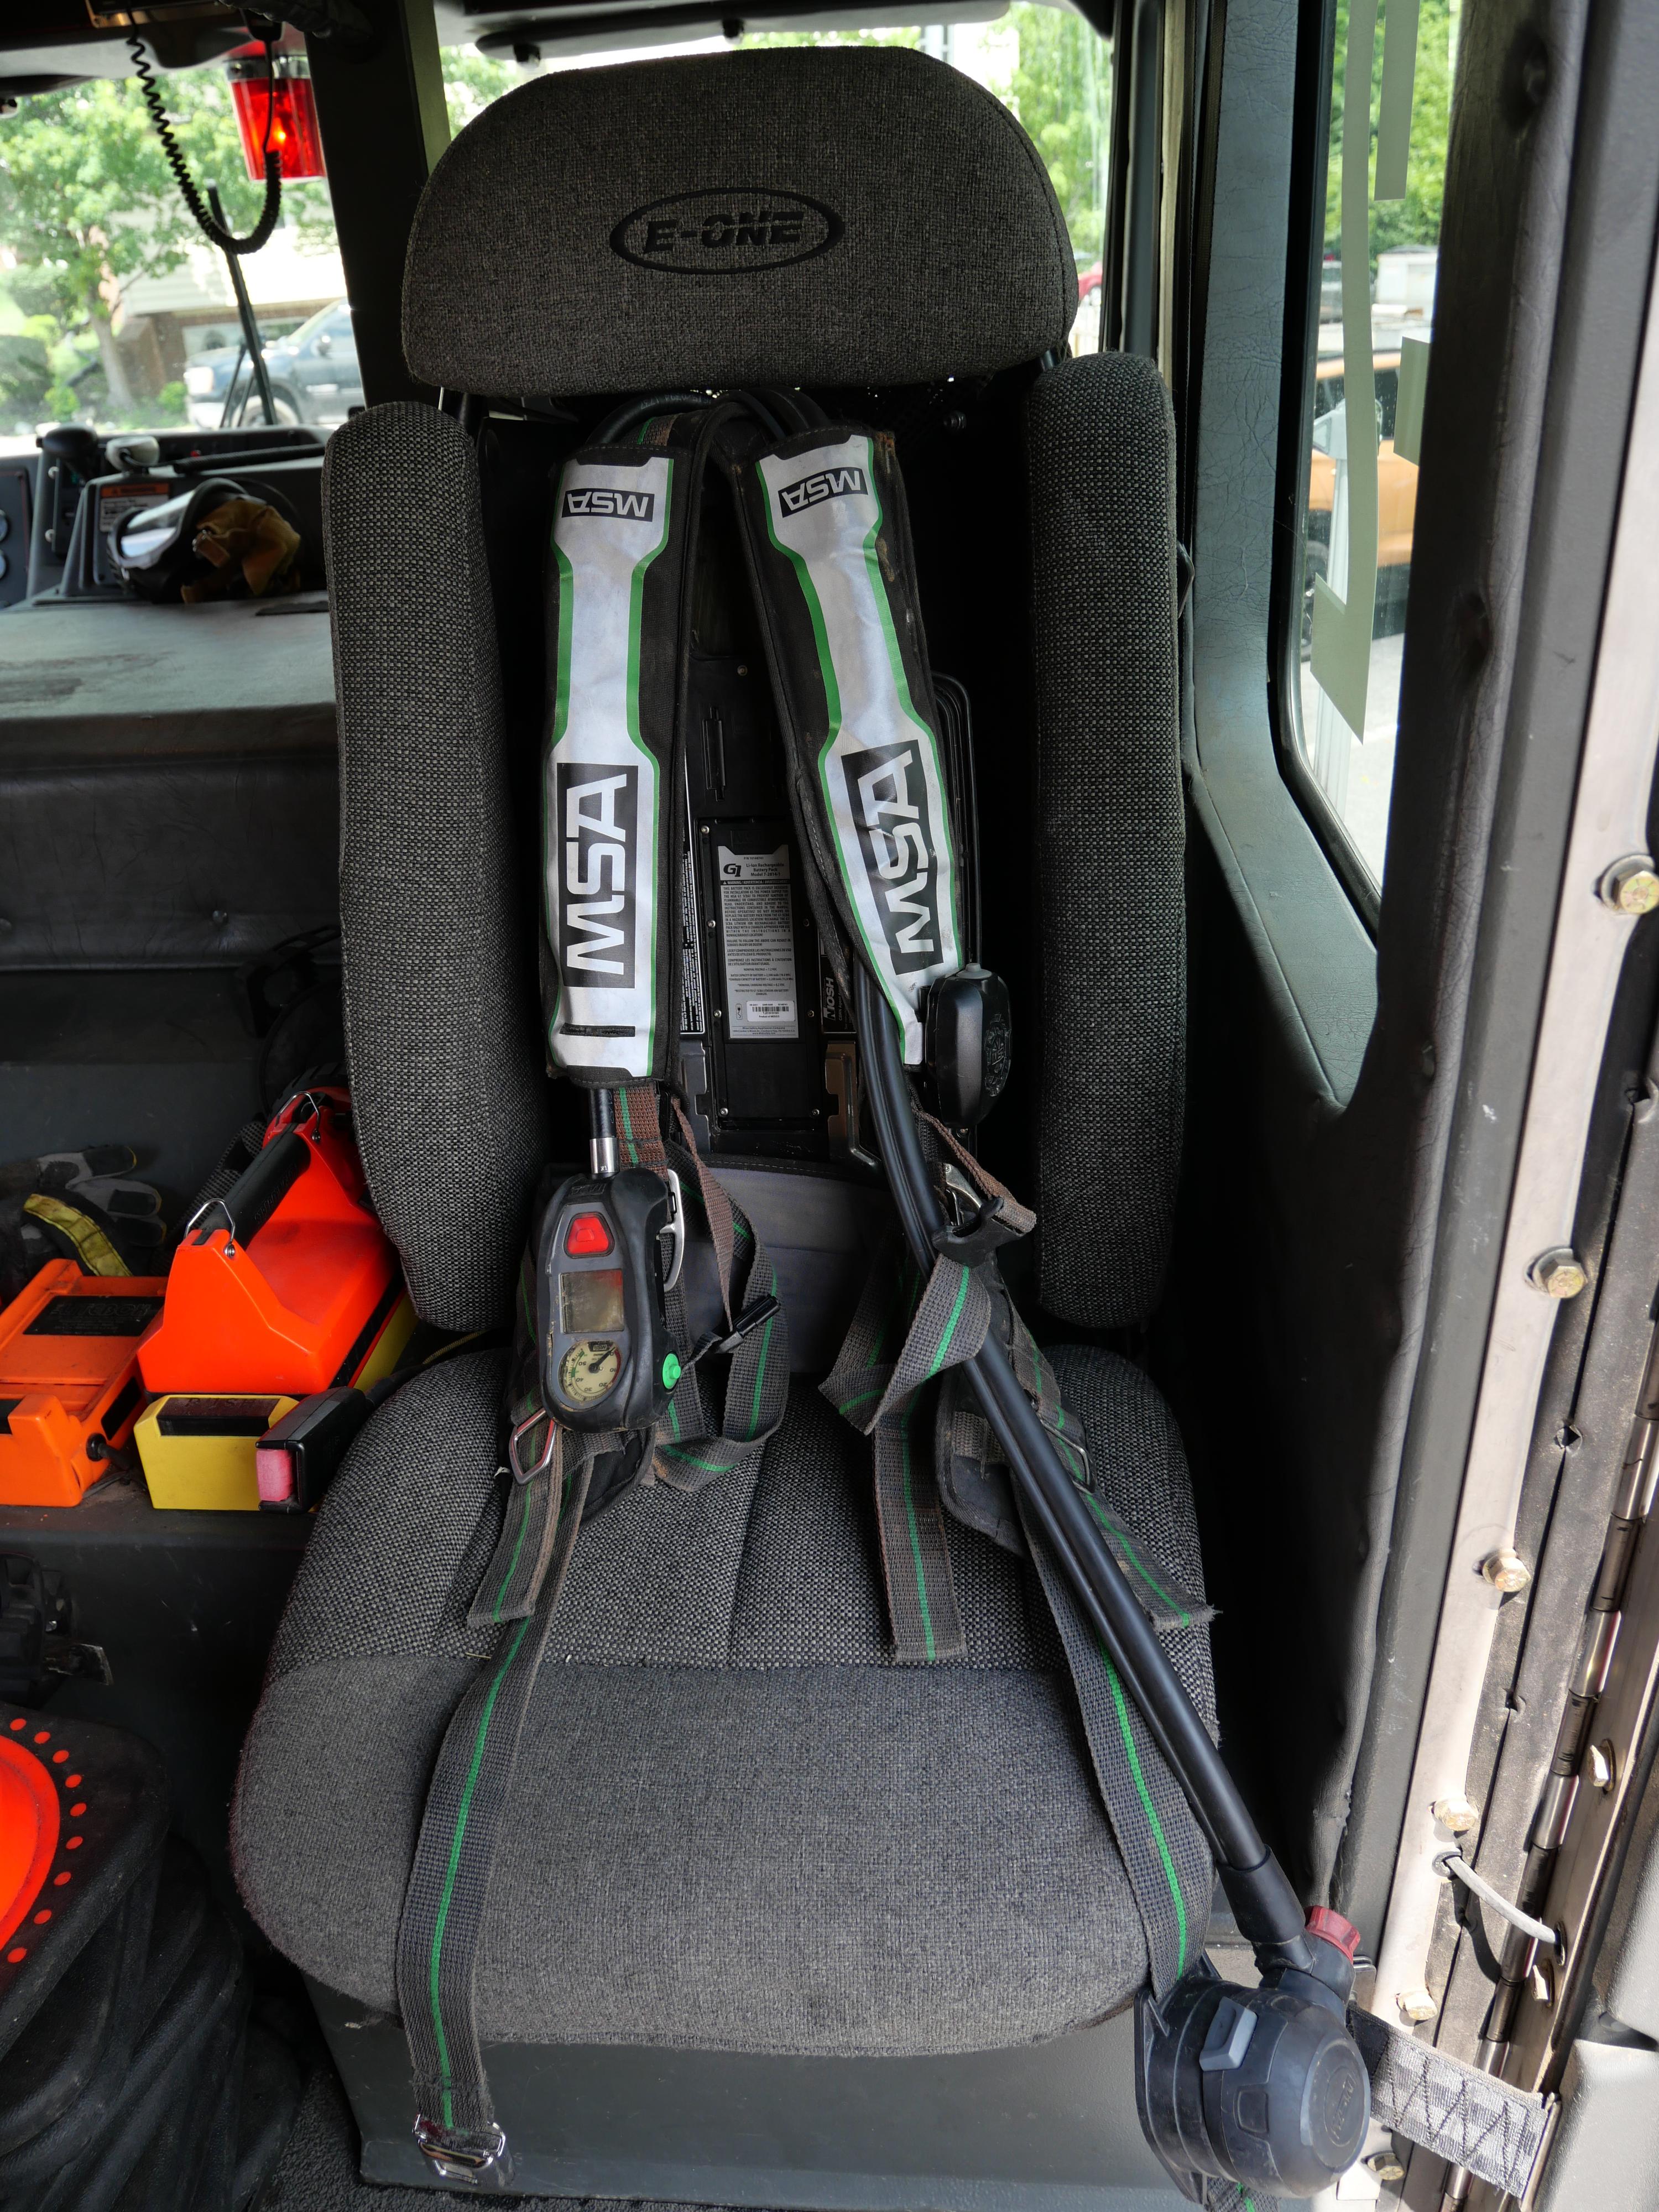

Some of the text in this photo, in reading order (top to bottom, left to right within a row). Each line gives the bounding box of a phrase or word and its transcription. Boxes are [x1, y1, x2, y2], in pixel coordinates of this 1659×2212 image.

[643, 211, 804, 254] E-ONE
[567, 492, 649, 518] MSA
[781, 470, 861, 511] MSA
[723, 864, 741, 877] G1
[857, 749, 934, 954] MSA
[566, 774, 628, 975] MSA
[823, 977, 836, 1021] NIOSH
